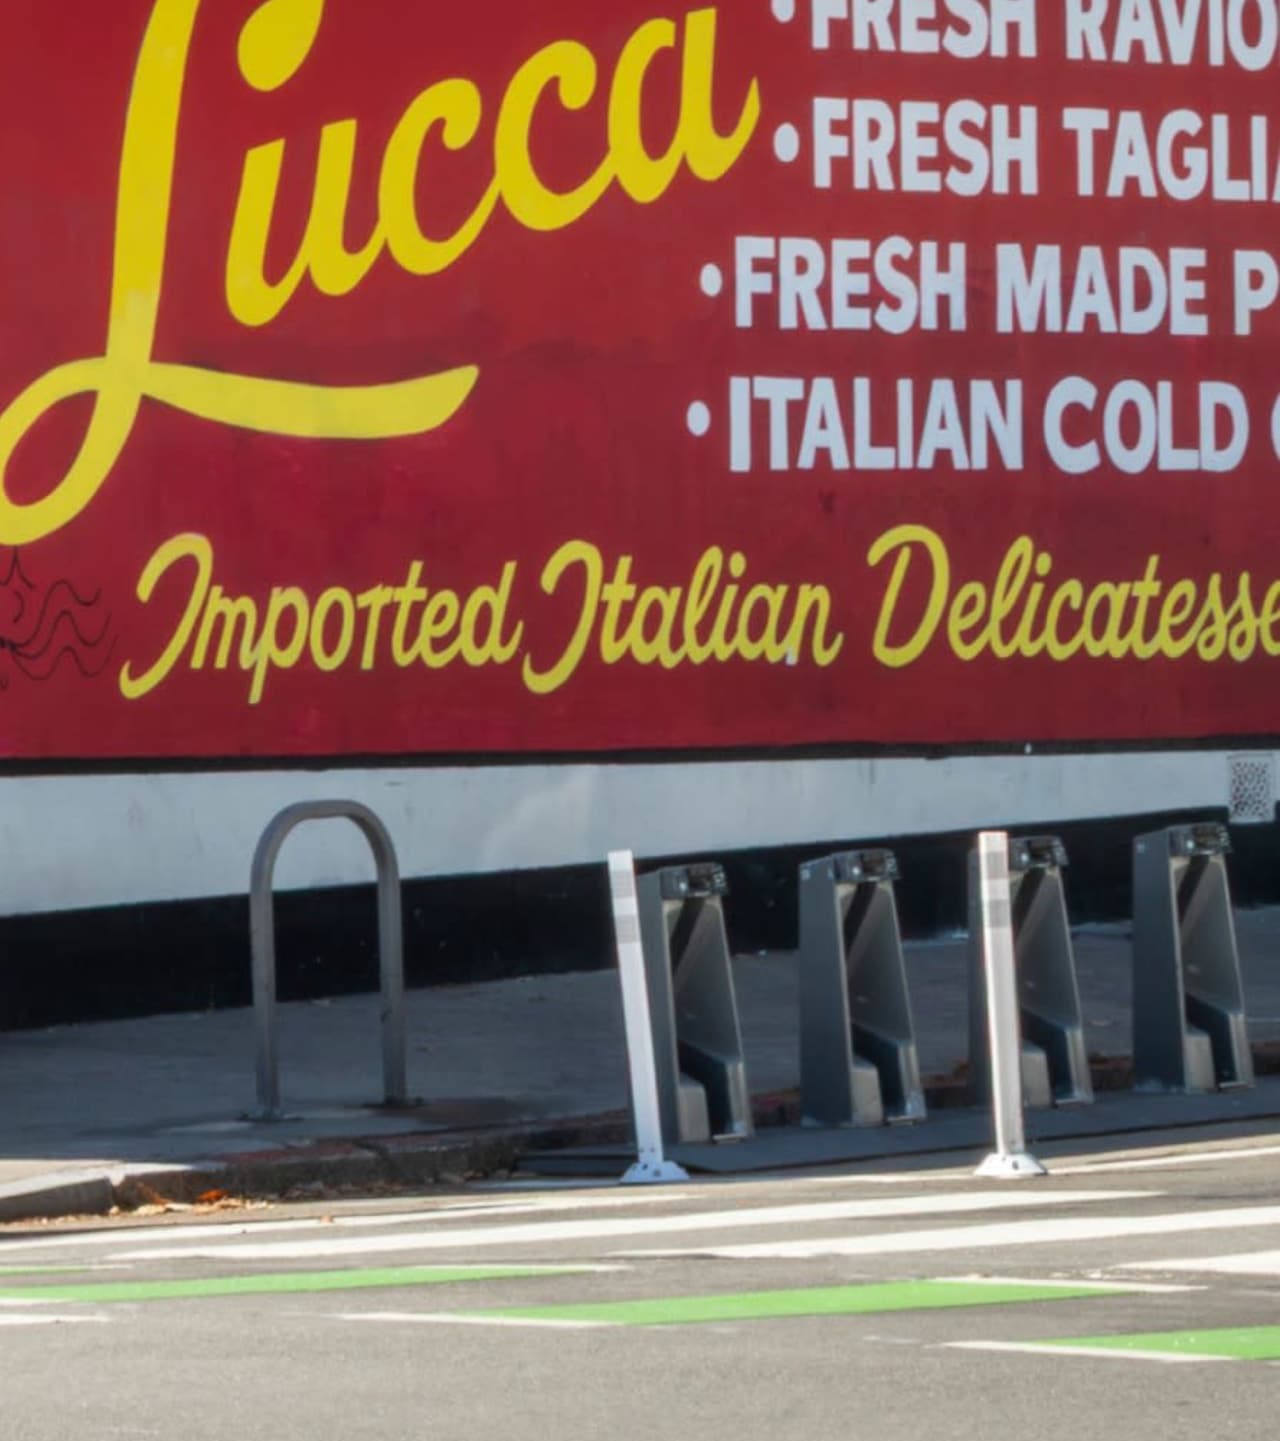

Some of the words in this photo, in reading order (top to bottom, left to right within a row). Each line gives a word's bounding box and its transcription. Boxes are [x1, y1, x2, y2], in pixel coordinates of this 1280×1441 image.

[812, 97, 1039, 197] FRESH
[1063, 105, 1280, 203] TAGLI
[735, 235, 966, 331] FRESH
[996, 243, 1208, 336] MADE
[1234, 249, 1280, 336] P
[730, 376, 1024, 472] ITALIAN
[1044, 375, 1248, 475] COLD
[120, 533, 525, 705] Imported
[521, 538, 844, 696] Italian
[867, 524, 1280, 668] Delicatesse
